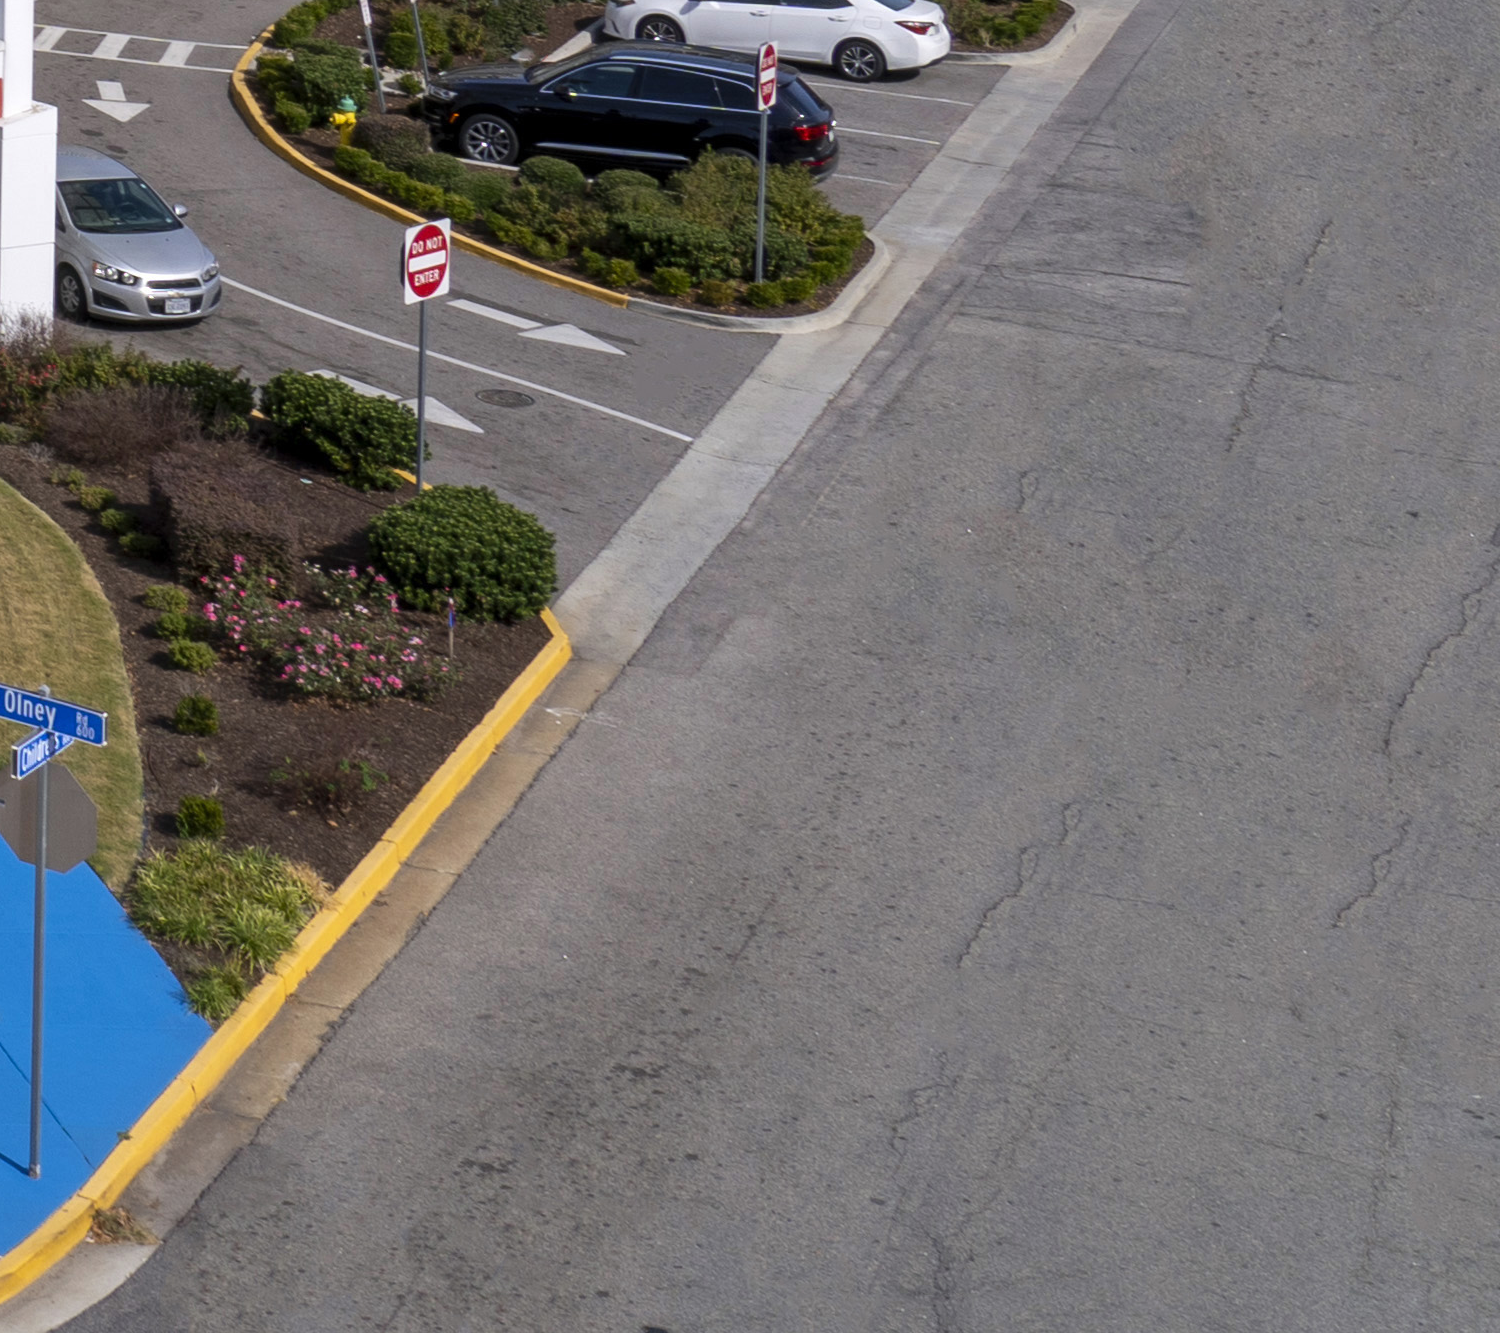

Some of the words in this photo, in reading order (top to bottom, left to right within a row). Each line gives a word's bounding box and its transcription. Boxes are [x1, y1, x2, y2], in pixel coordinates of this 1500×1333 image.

[412, 240, 424, 254] DO
[426, 235, 443, 250] NOT
[414, 268, 440, 287] ENTER
[4, 690, 56, 731] Olney
[76, 711, 89, 727] Rd
[76, 724, 95, 740] 600
